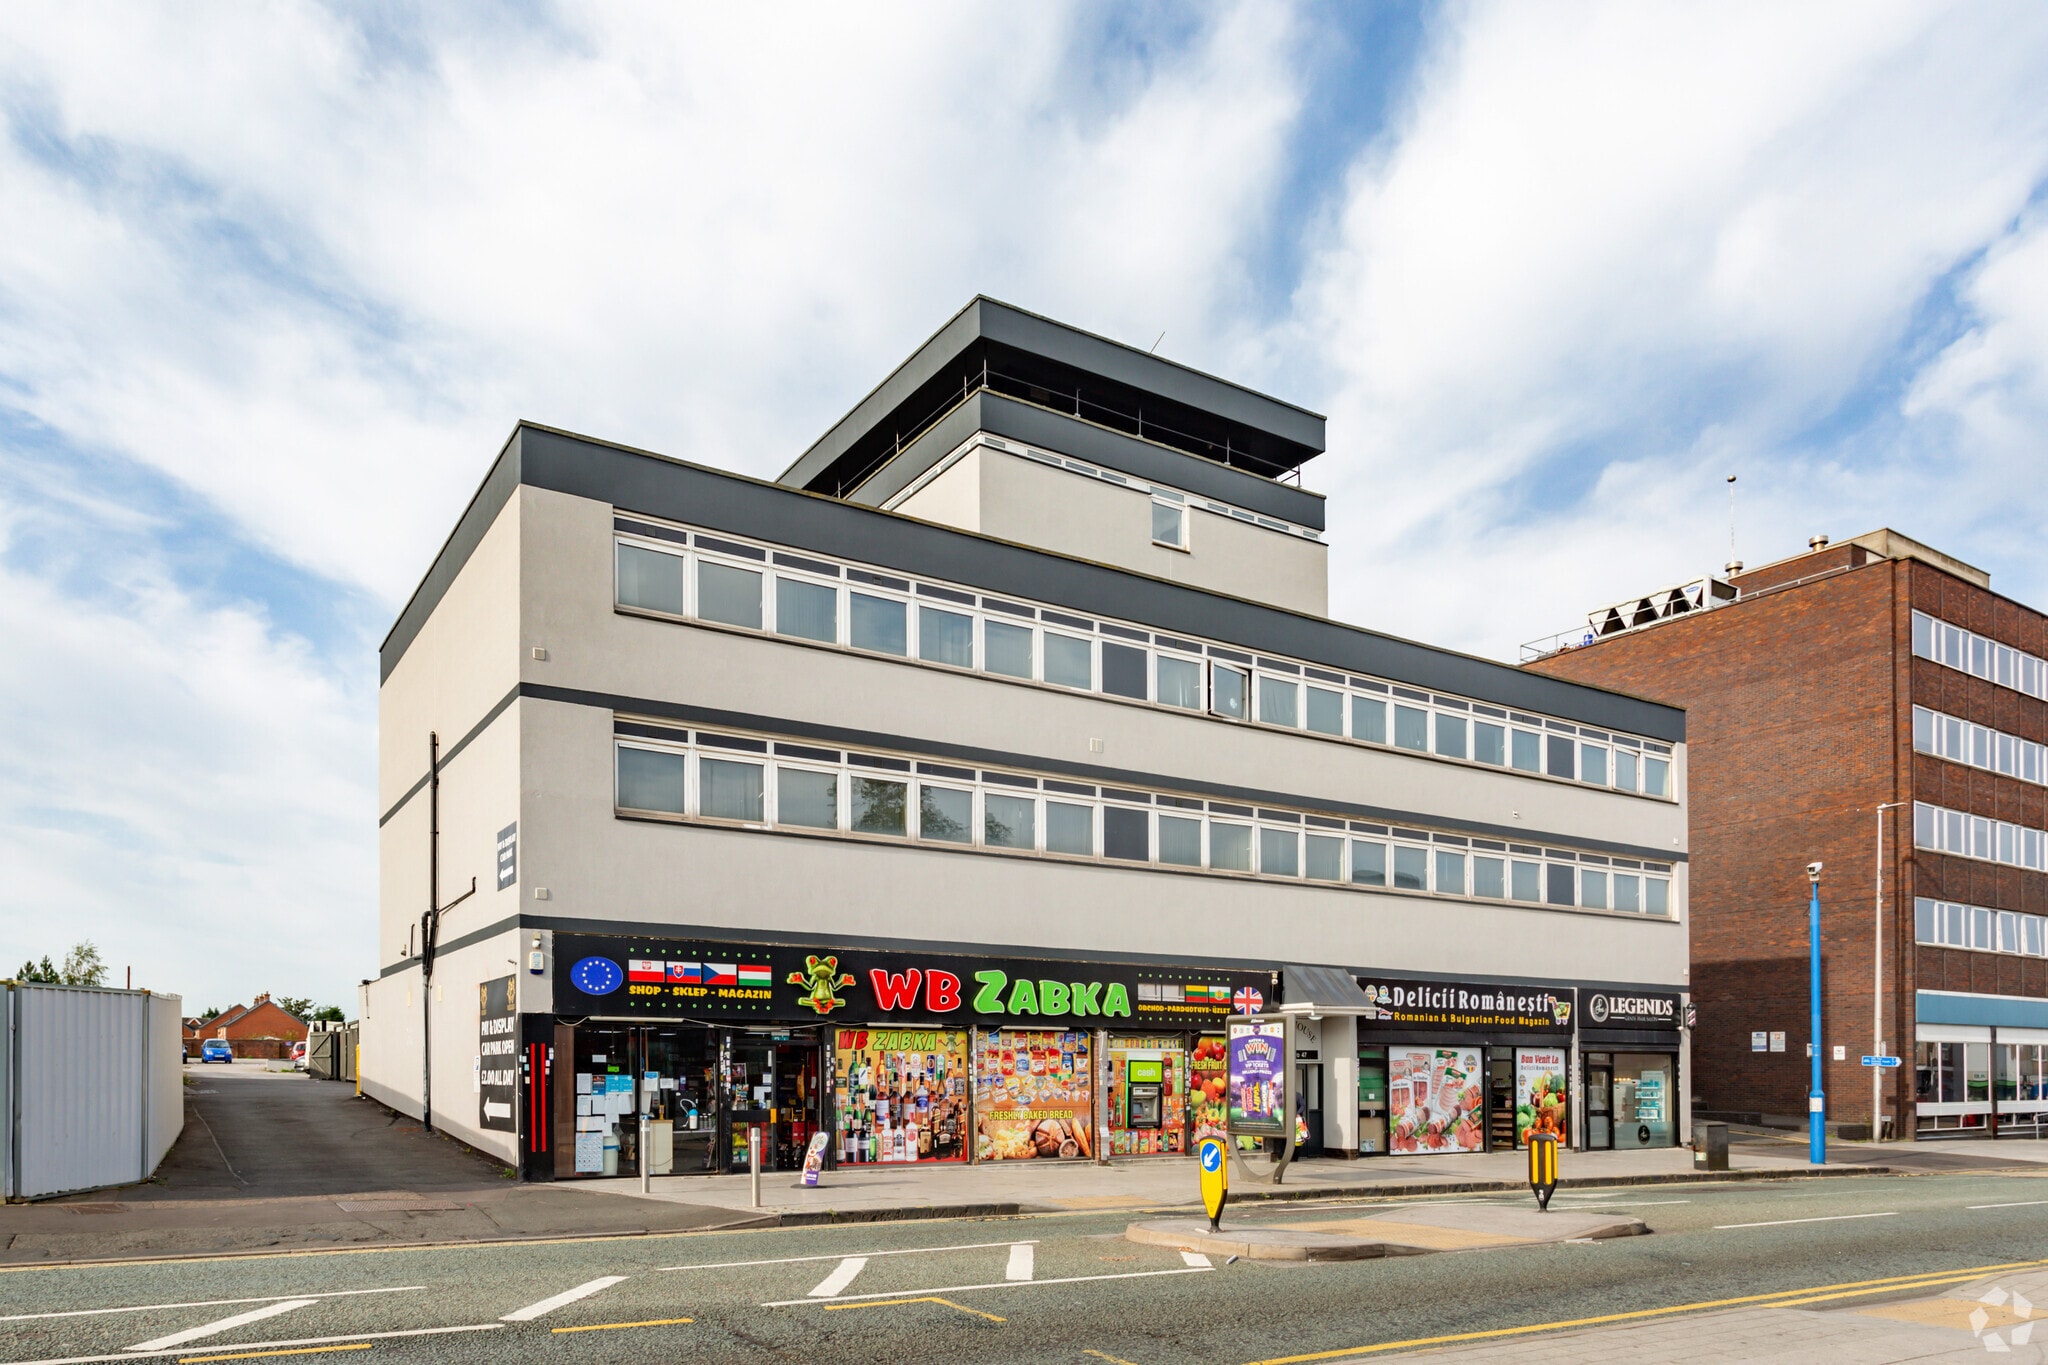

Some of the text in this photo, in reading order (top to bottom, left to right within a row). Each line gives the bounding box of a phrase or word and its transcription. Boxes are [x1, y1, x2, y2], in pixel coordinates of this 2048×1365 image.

[629, 984, 661, 996] SHOP
[672, 985, 708, 997] SKLEP
[718, 988, 772, 999] MAGAZIN
[869, 967, 1131, 1018] WB ZABKA
[1393, 986, 1455, 1009] Delicii
[1609, 996, 1673, 1016] LEGENDS
[481, 1016, 515, 1036] PAY & DISPLAY
[1394, 1012, 1550, 1027] Romanian & Bulgarian Food Magazin
[481, 1039, 515, 1056] CAR PARK OPEN
[838, 1029, 938, 1051] WB ZABKA
[494, 1069, 502, 1085] ALL
[502, 1069, 514, 1085] DAY
[1137, 1068, 1155, 1077] cash
[989, 1110, 1073, 1120] FRESHLY BAKED BREAD
